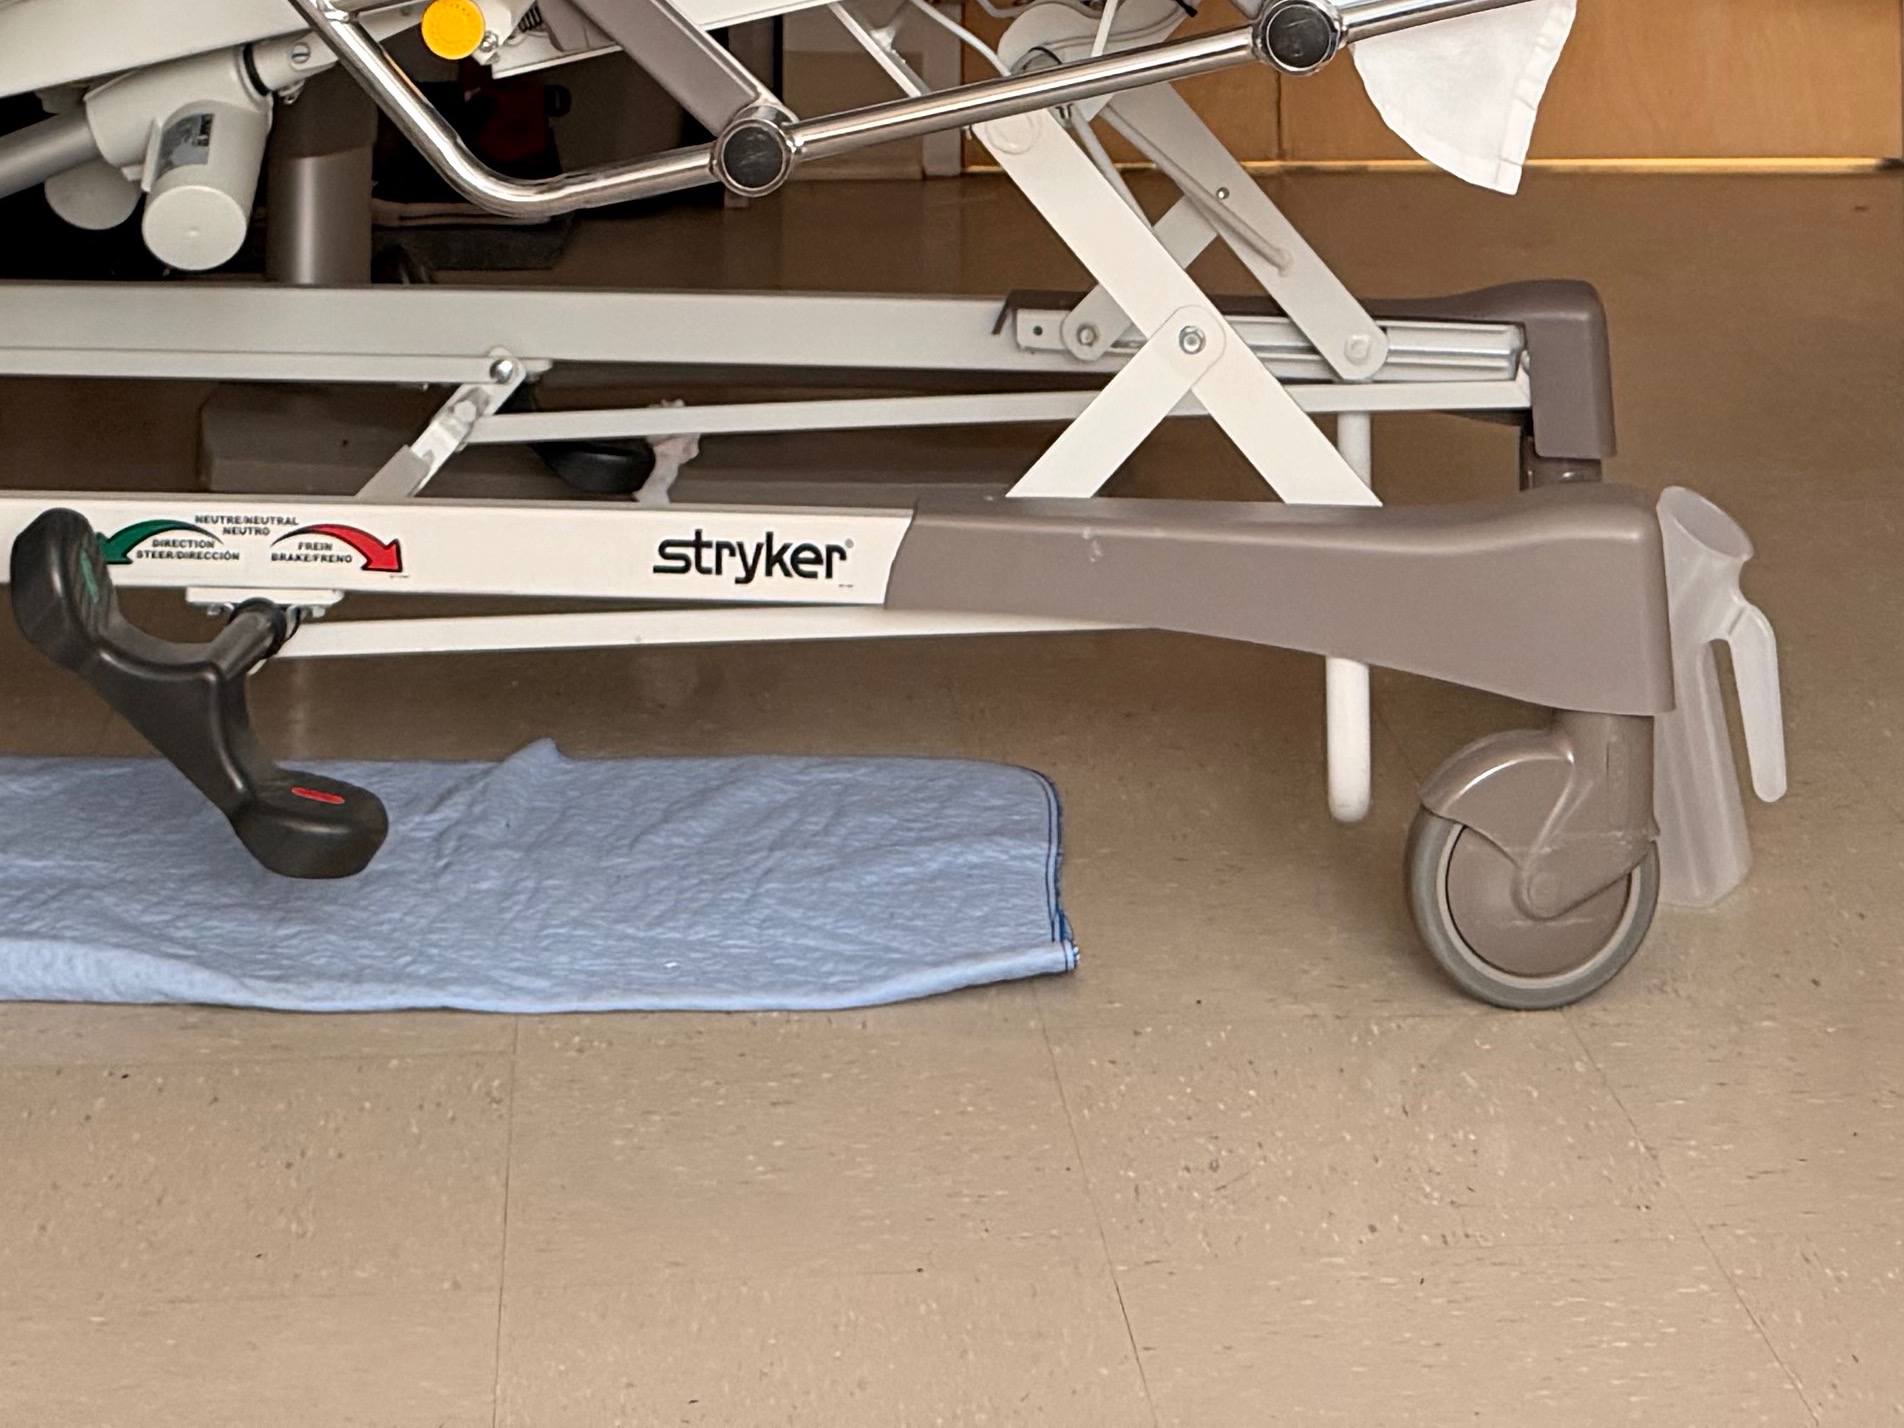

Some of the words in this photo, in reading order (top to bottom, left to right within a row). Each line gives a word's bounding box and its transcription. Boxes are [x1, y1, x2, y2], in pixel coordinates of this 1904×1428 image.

[195, 514, 300, 527] NEUTRE/NEUTRAL
[222, 526, 271, 537] NEUTRO
[152, 539, 216, 550] DIRECTION
[298, 541, 333, 552] FREIN
[136, 549, 241, 562] STEER/DIRECCIÓN
[271, 552, 353, 564] BRAKE/FRENO
[652, 527, 847, 585] stryker
